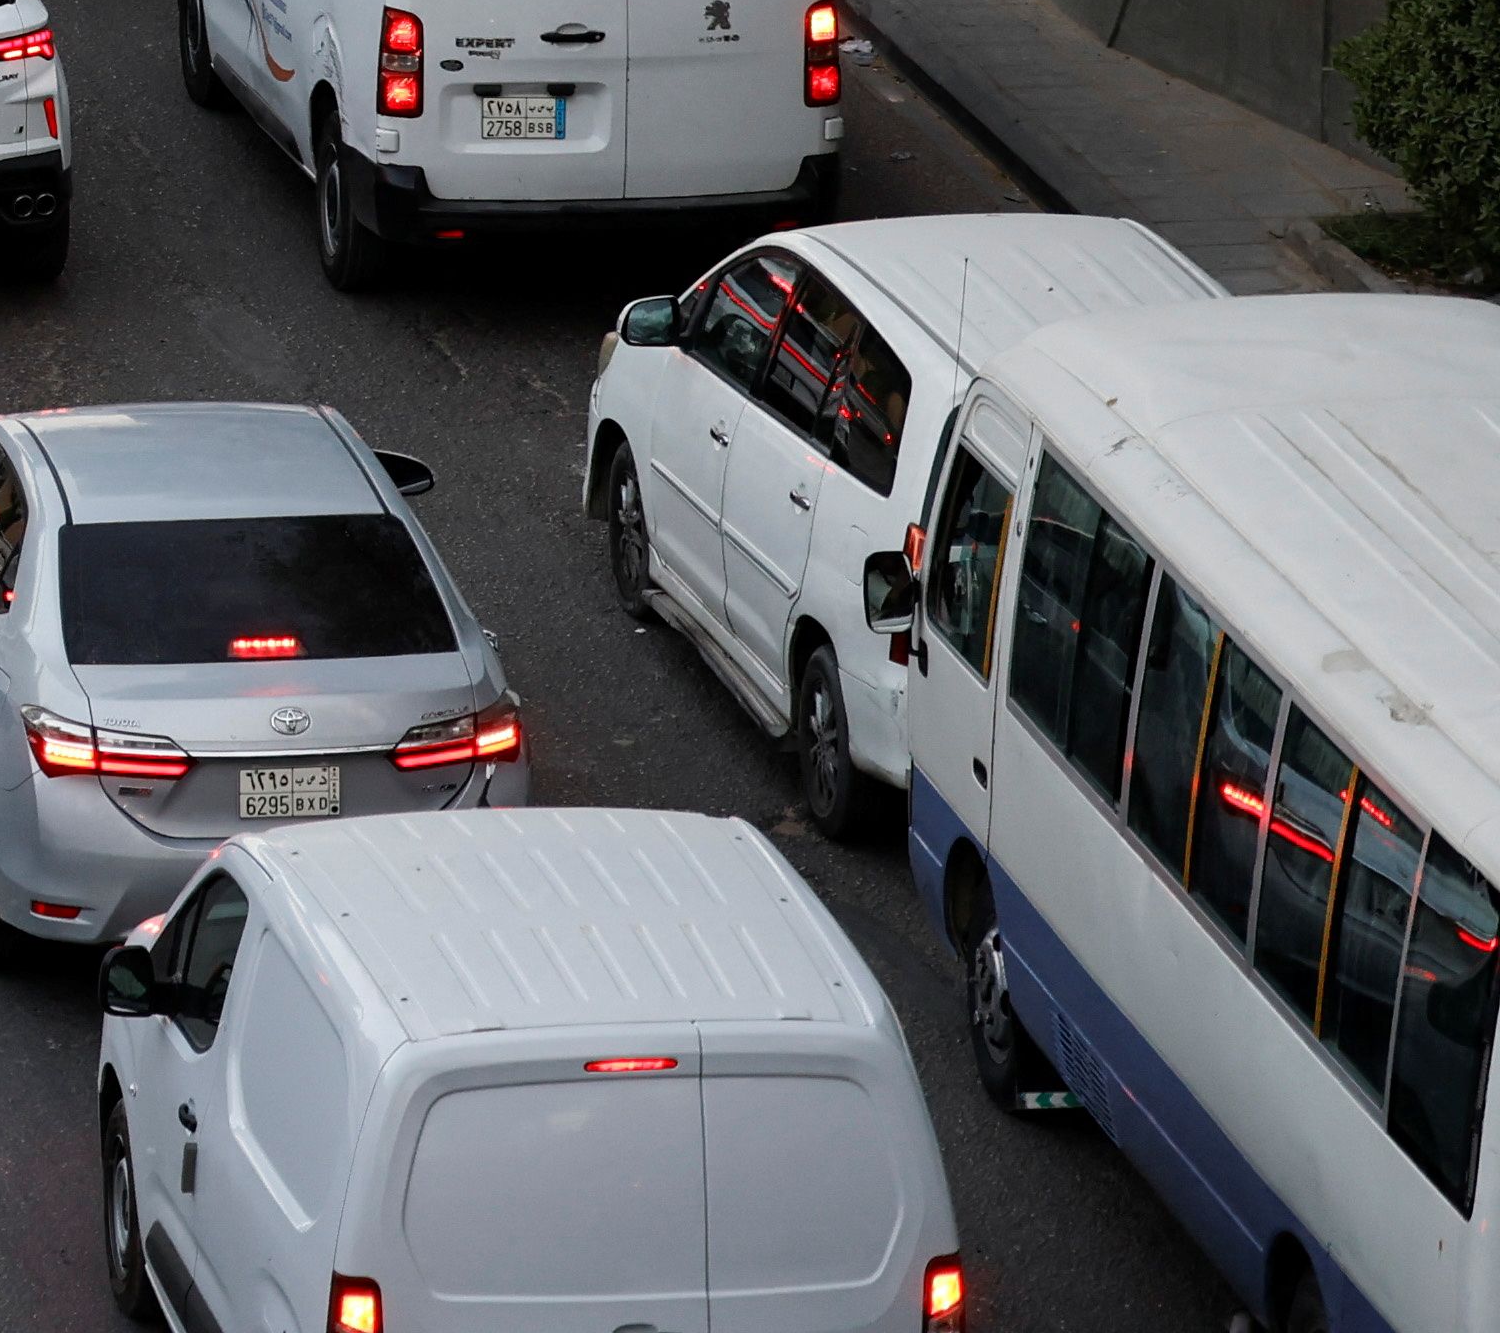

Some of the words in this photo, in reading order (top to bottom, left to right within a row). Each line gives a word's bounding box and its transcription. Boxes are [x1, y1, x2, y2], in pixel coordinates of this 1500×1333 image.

[454, 37, 515, 49] EXPERT
[487, 100, 522, 116] ٢٧٥٨
[486, 120, 522, 137] 2758
[528, 122, 553, 134] BSB
[102, 717, 141, 728] TOYOTA
[245, 771, 288, 791] ٦٢٩٥
[246, 795, 290, 816] 6295
[296, 796, 328, 811] BXD
